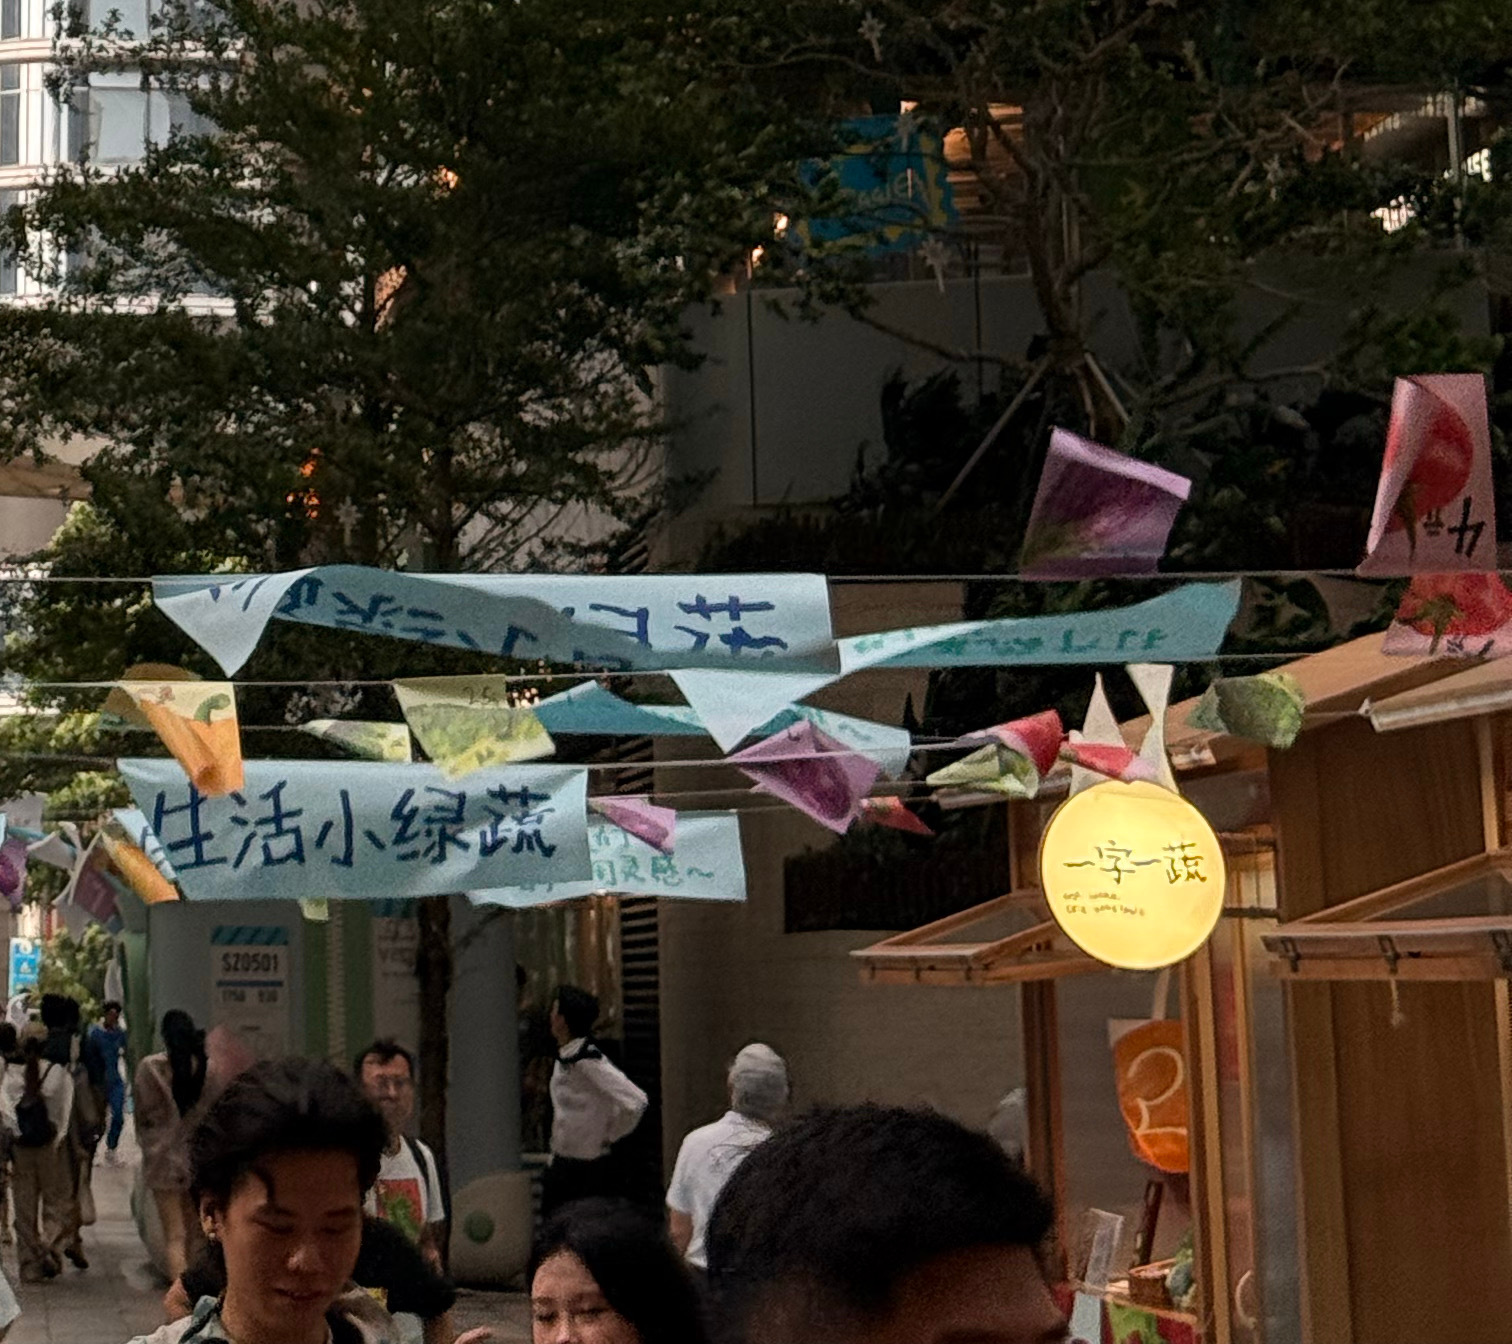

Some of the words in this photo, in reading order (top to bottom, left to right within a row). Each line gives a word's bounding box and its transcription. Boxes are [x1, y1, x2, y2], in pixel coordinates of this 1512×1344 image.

[152, 780, 556, 870] 生活小绿蔬
[1063, 840, 1207, 885] 一字一蔬
[222, 952, 279, 972] SZ0501
